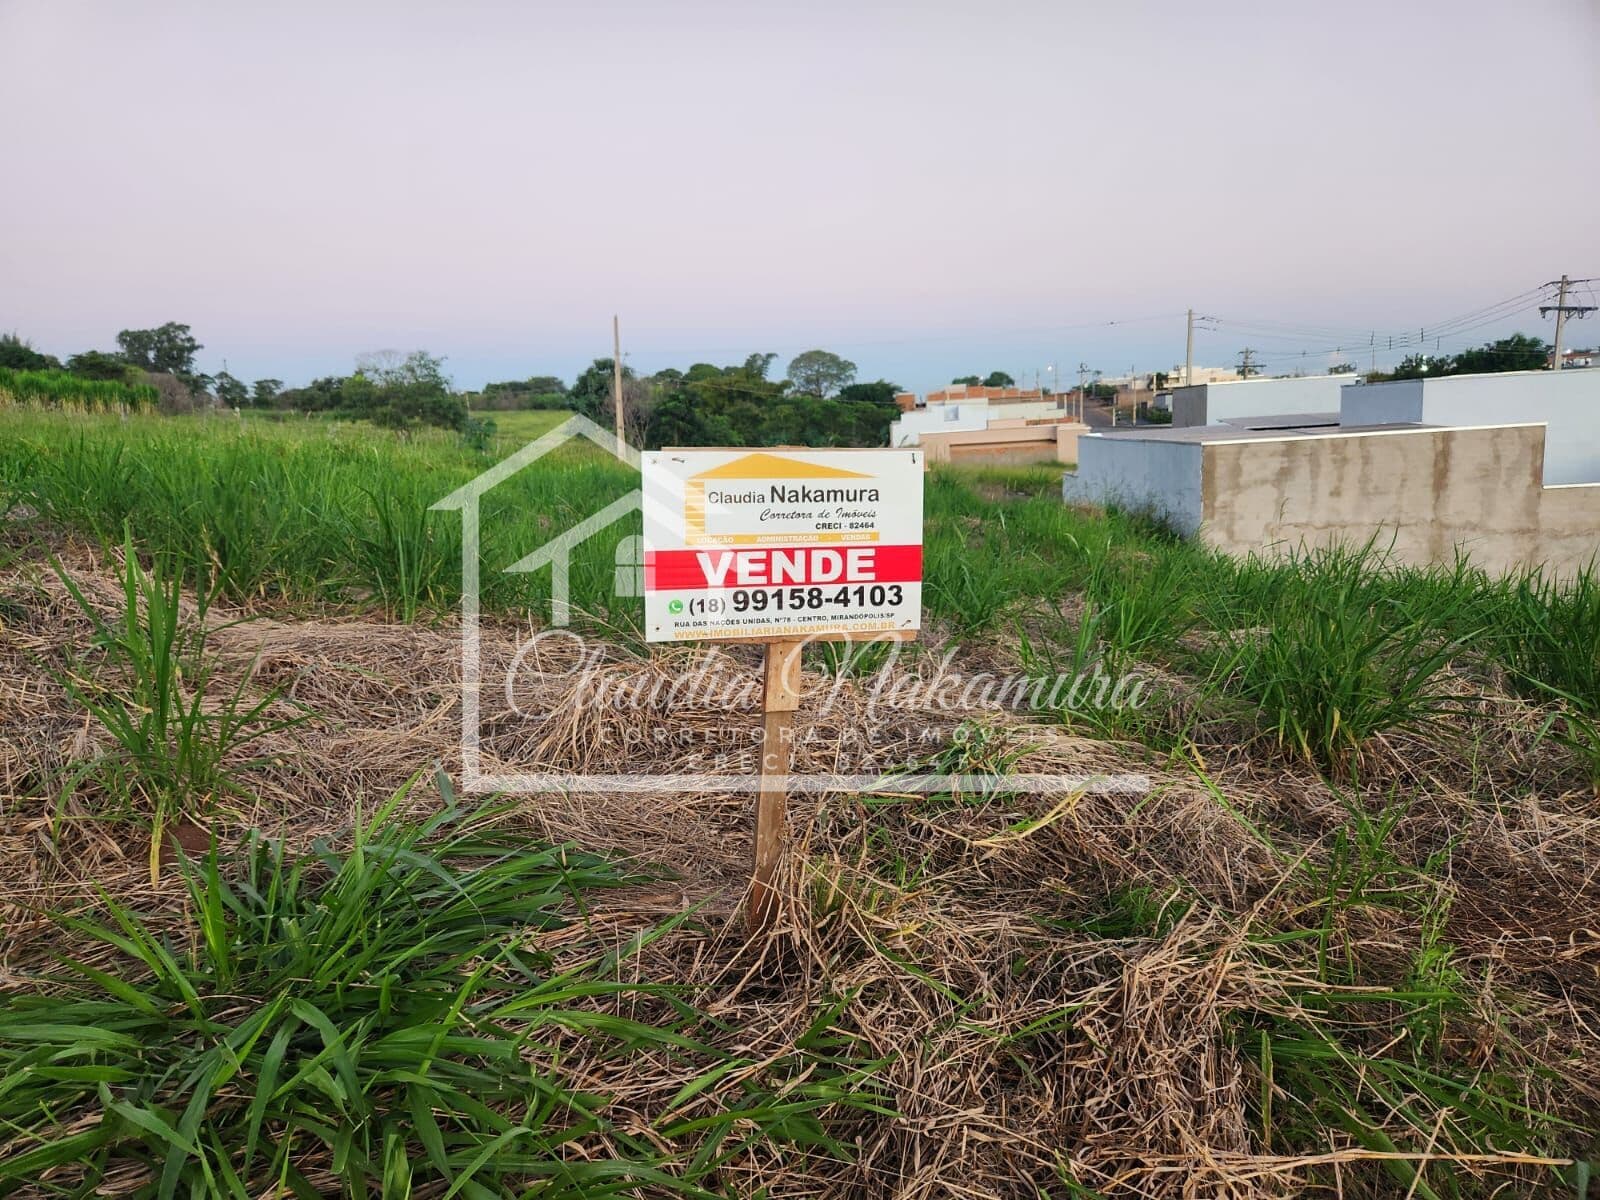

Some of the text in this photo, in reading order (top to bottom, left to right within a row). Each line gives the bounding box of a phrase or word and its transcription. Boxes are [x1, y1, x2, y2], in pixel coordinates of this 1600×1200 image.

[708, 485, 880, 504] Claudia Nakamura
[760, 508, 813, 522] Corretora
[818, 508, 831, 519] de
[815, 522, 842, 531] CRECI
[849, 521, 875, 530] 82464
[841, 533, 872, 541] VENDAS
[696, 548, 877, 587] VENDE
[689, 585, 904, 617] (18) 99158-4103
[674, 620, 690, 628] RUA
[742, 617, 773, 625] UNIDAS,
[797, 615, 829, 623] CENTRO,
